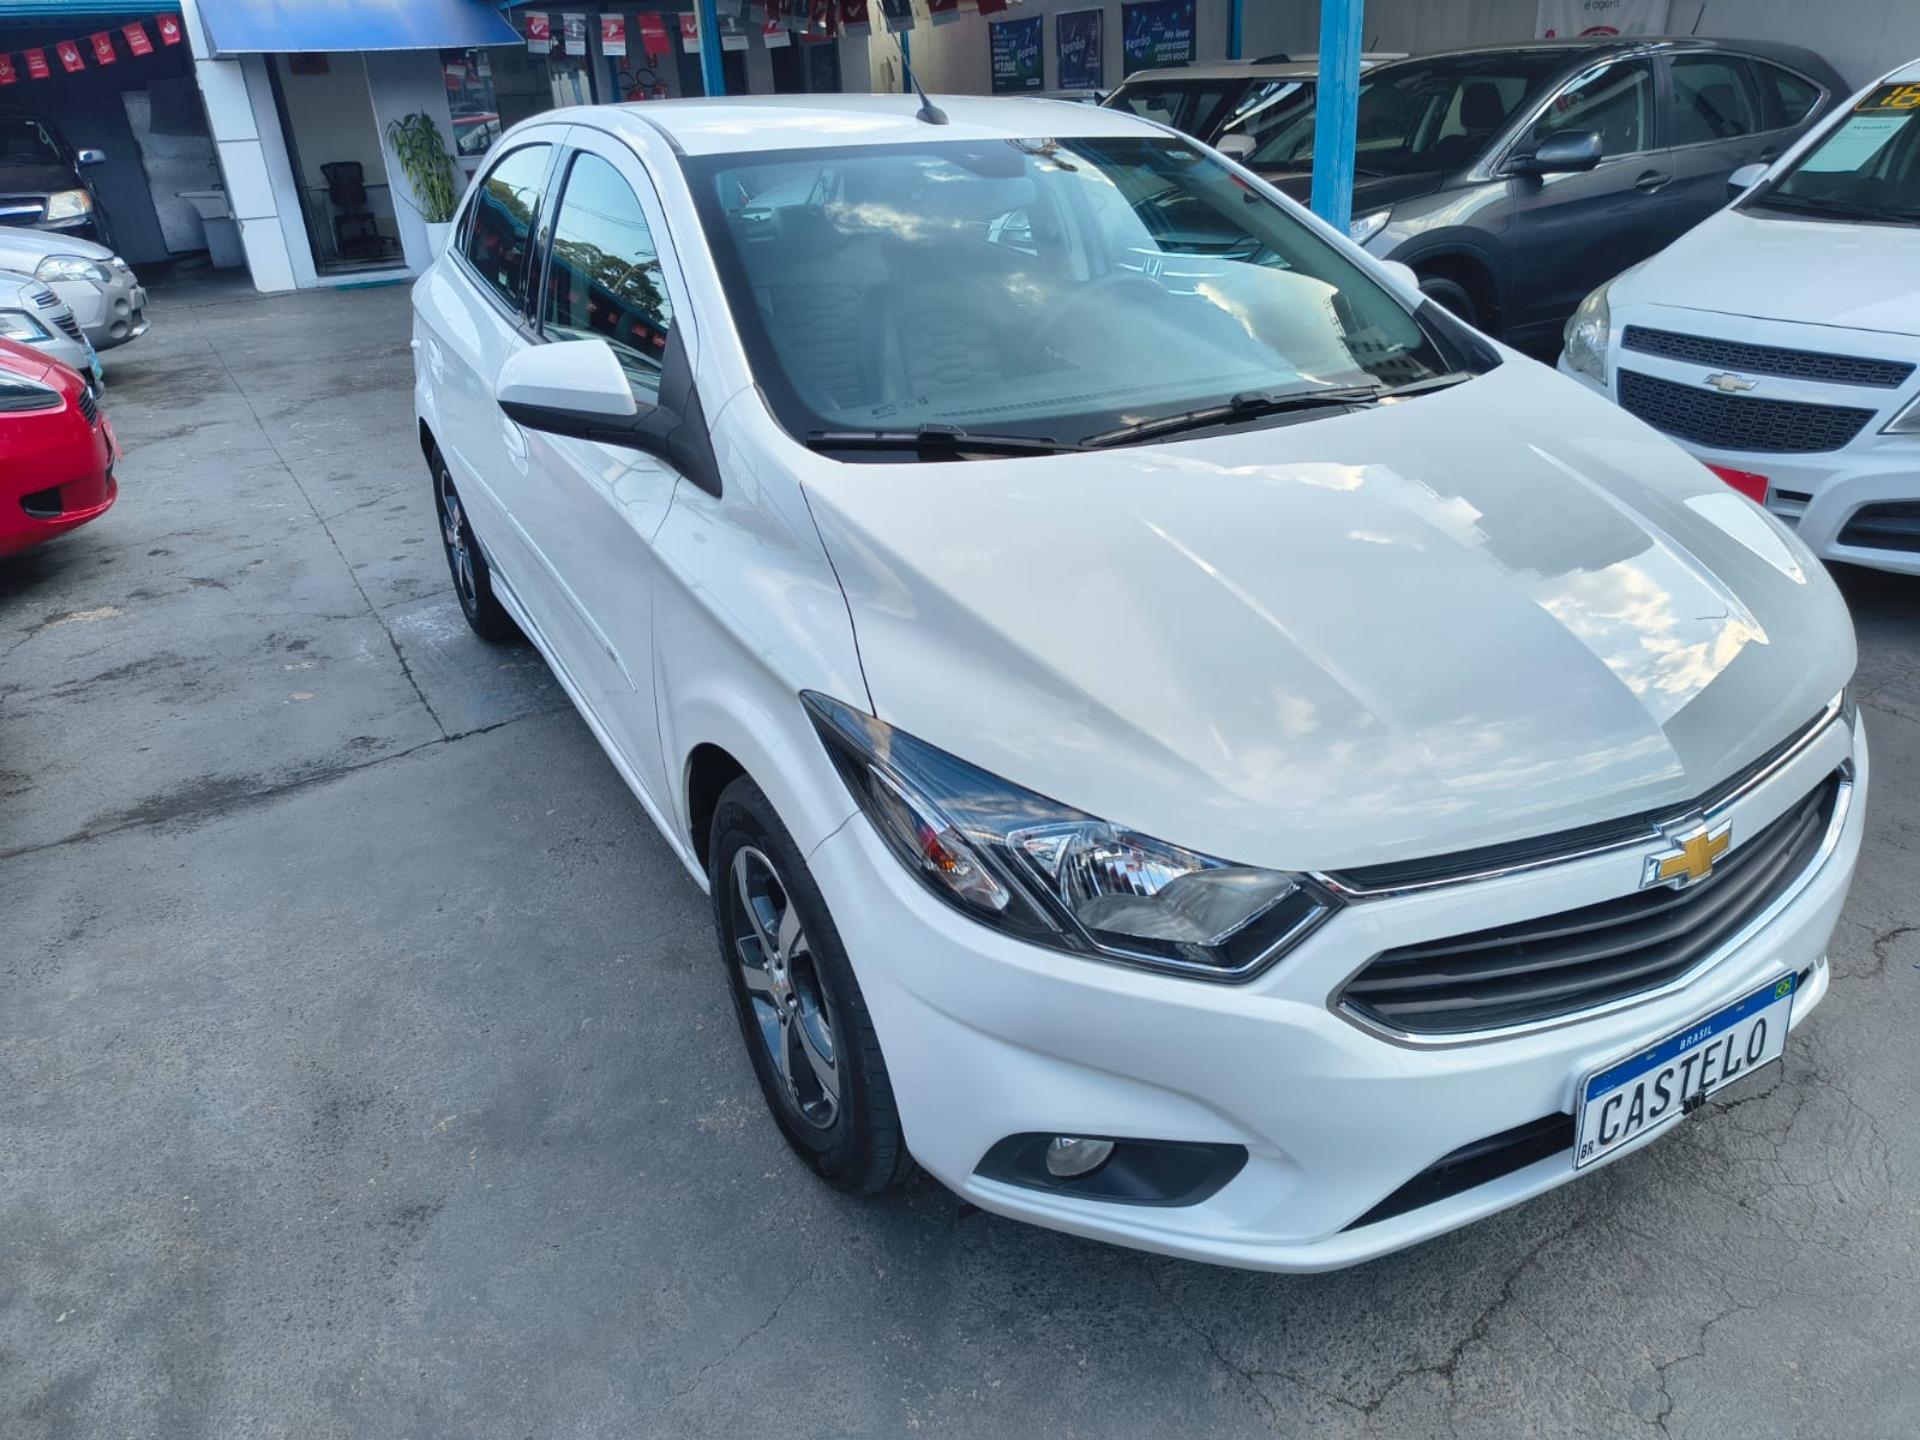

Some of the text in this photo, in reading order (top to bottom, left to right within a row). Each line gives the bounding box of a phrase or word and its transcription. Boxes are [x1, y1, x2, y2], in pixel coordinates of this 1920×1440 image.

[1680, 1025, 1712, 1050] BRASIL
[1599, 1018, 1766, 1146] CASTELO
[1581, 1140, 1594, 1159] BR
